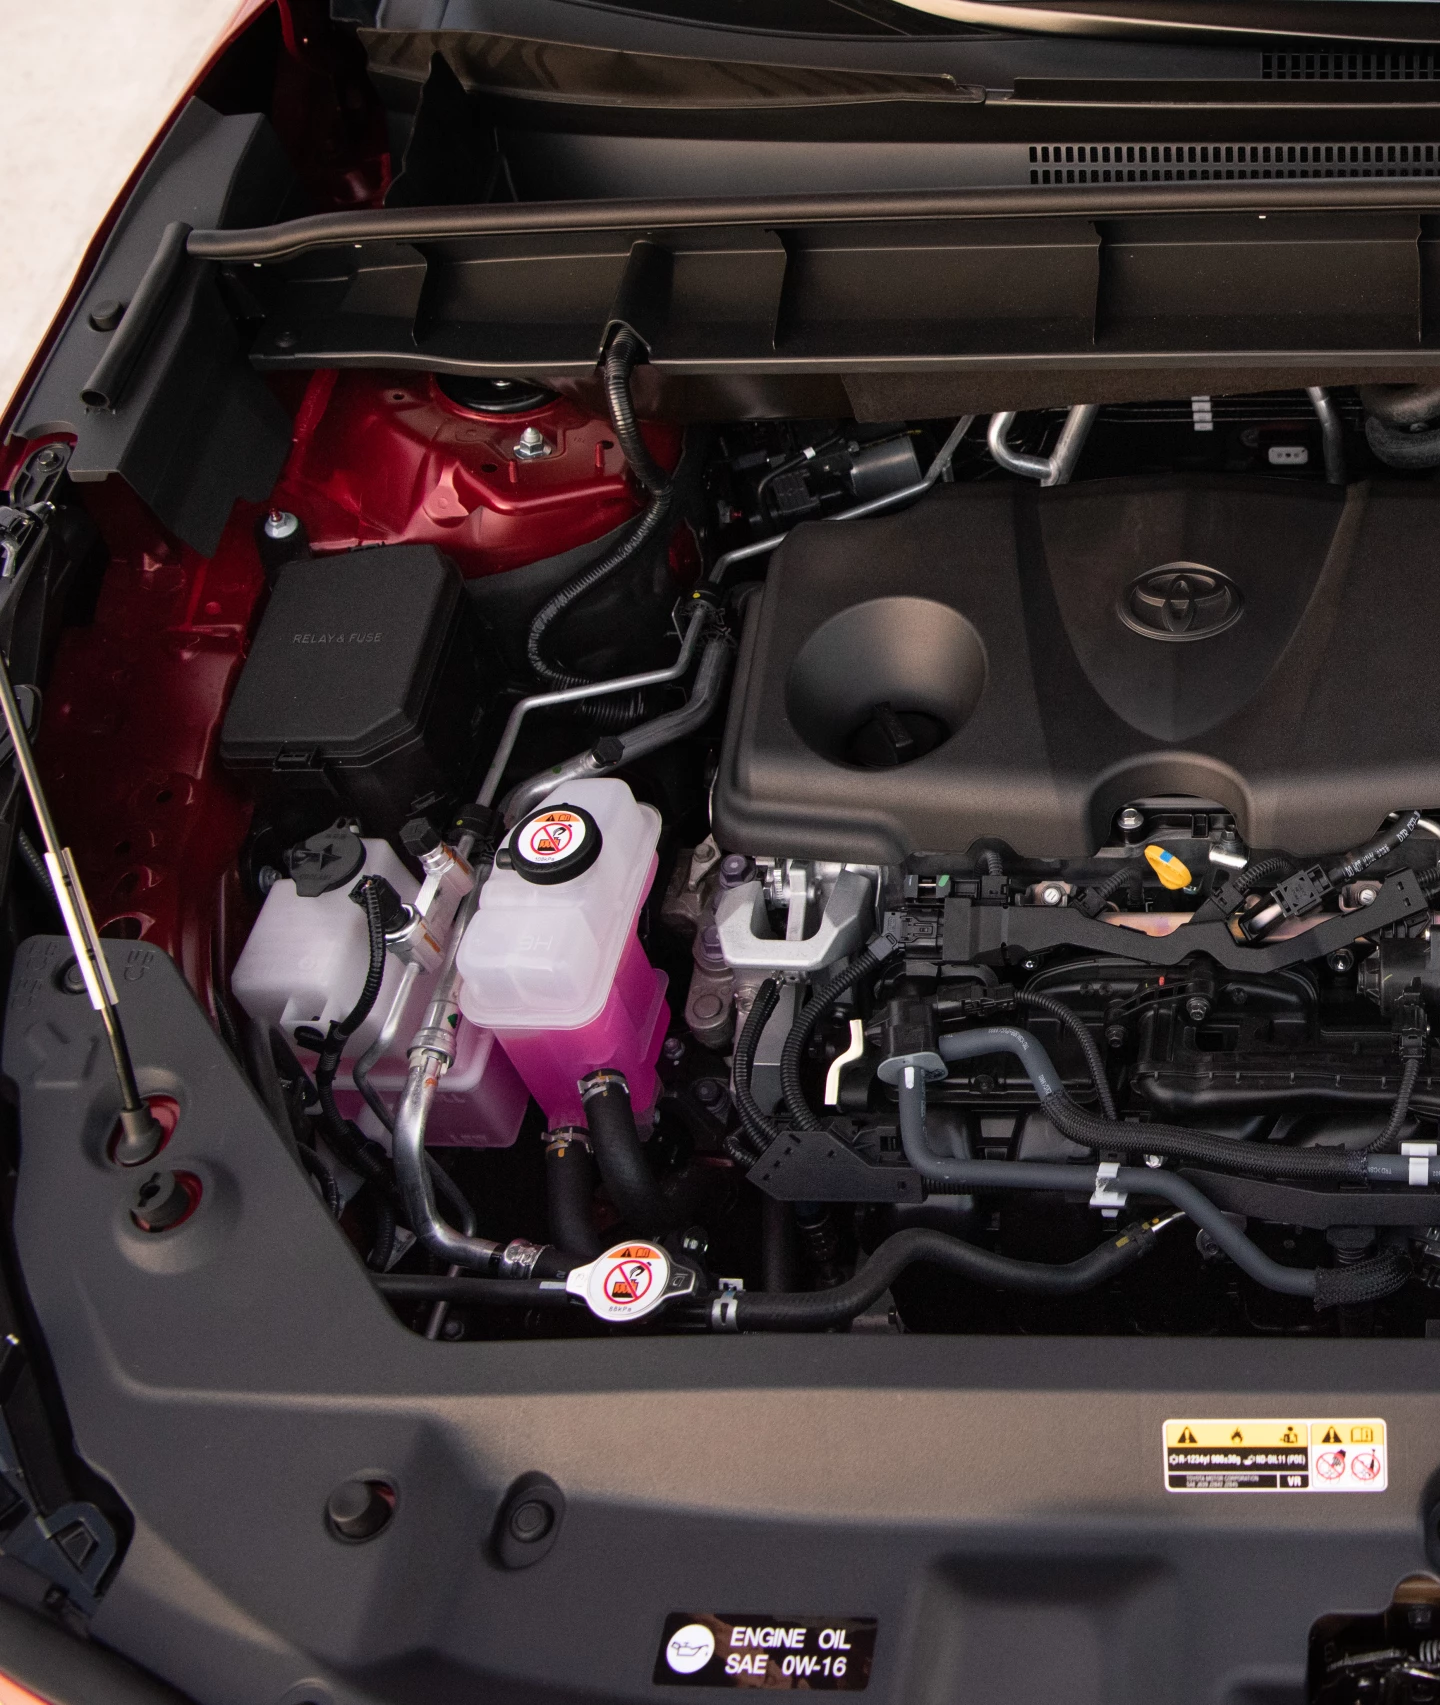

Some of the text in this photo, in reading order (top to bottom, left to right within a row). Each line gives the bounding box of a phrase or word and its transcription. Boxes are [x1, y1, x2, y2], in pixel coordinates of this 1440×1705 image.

[292, 633, 336, 644] RELAY
[349, 632, 383, 643] FUSE
[608, 1305, 632, 1313] 88kPa
[1286, 1475, 1302, 1487] VR
[730, 1626, 852, 1650] ENGINE OIL
[724, 1653, 848, 1677] SAE 0W-16
